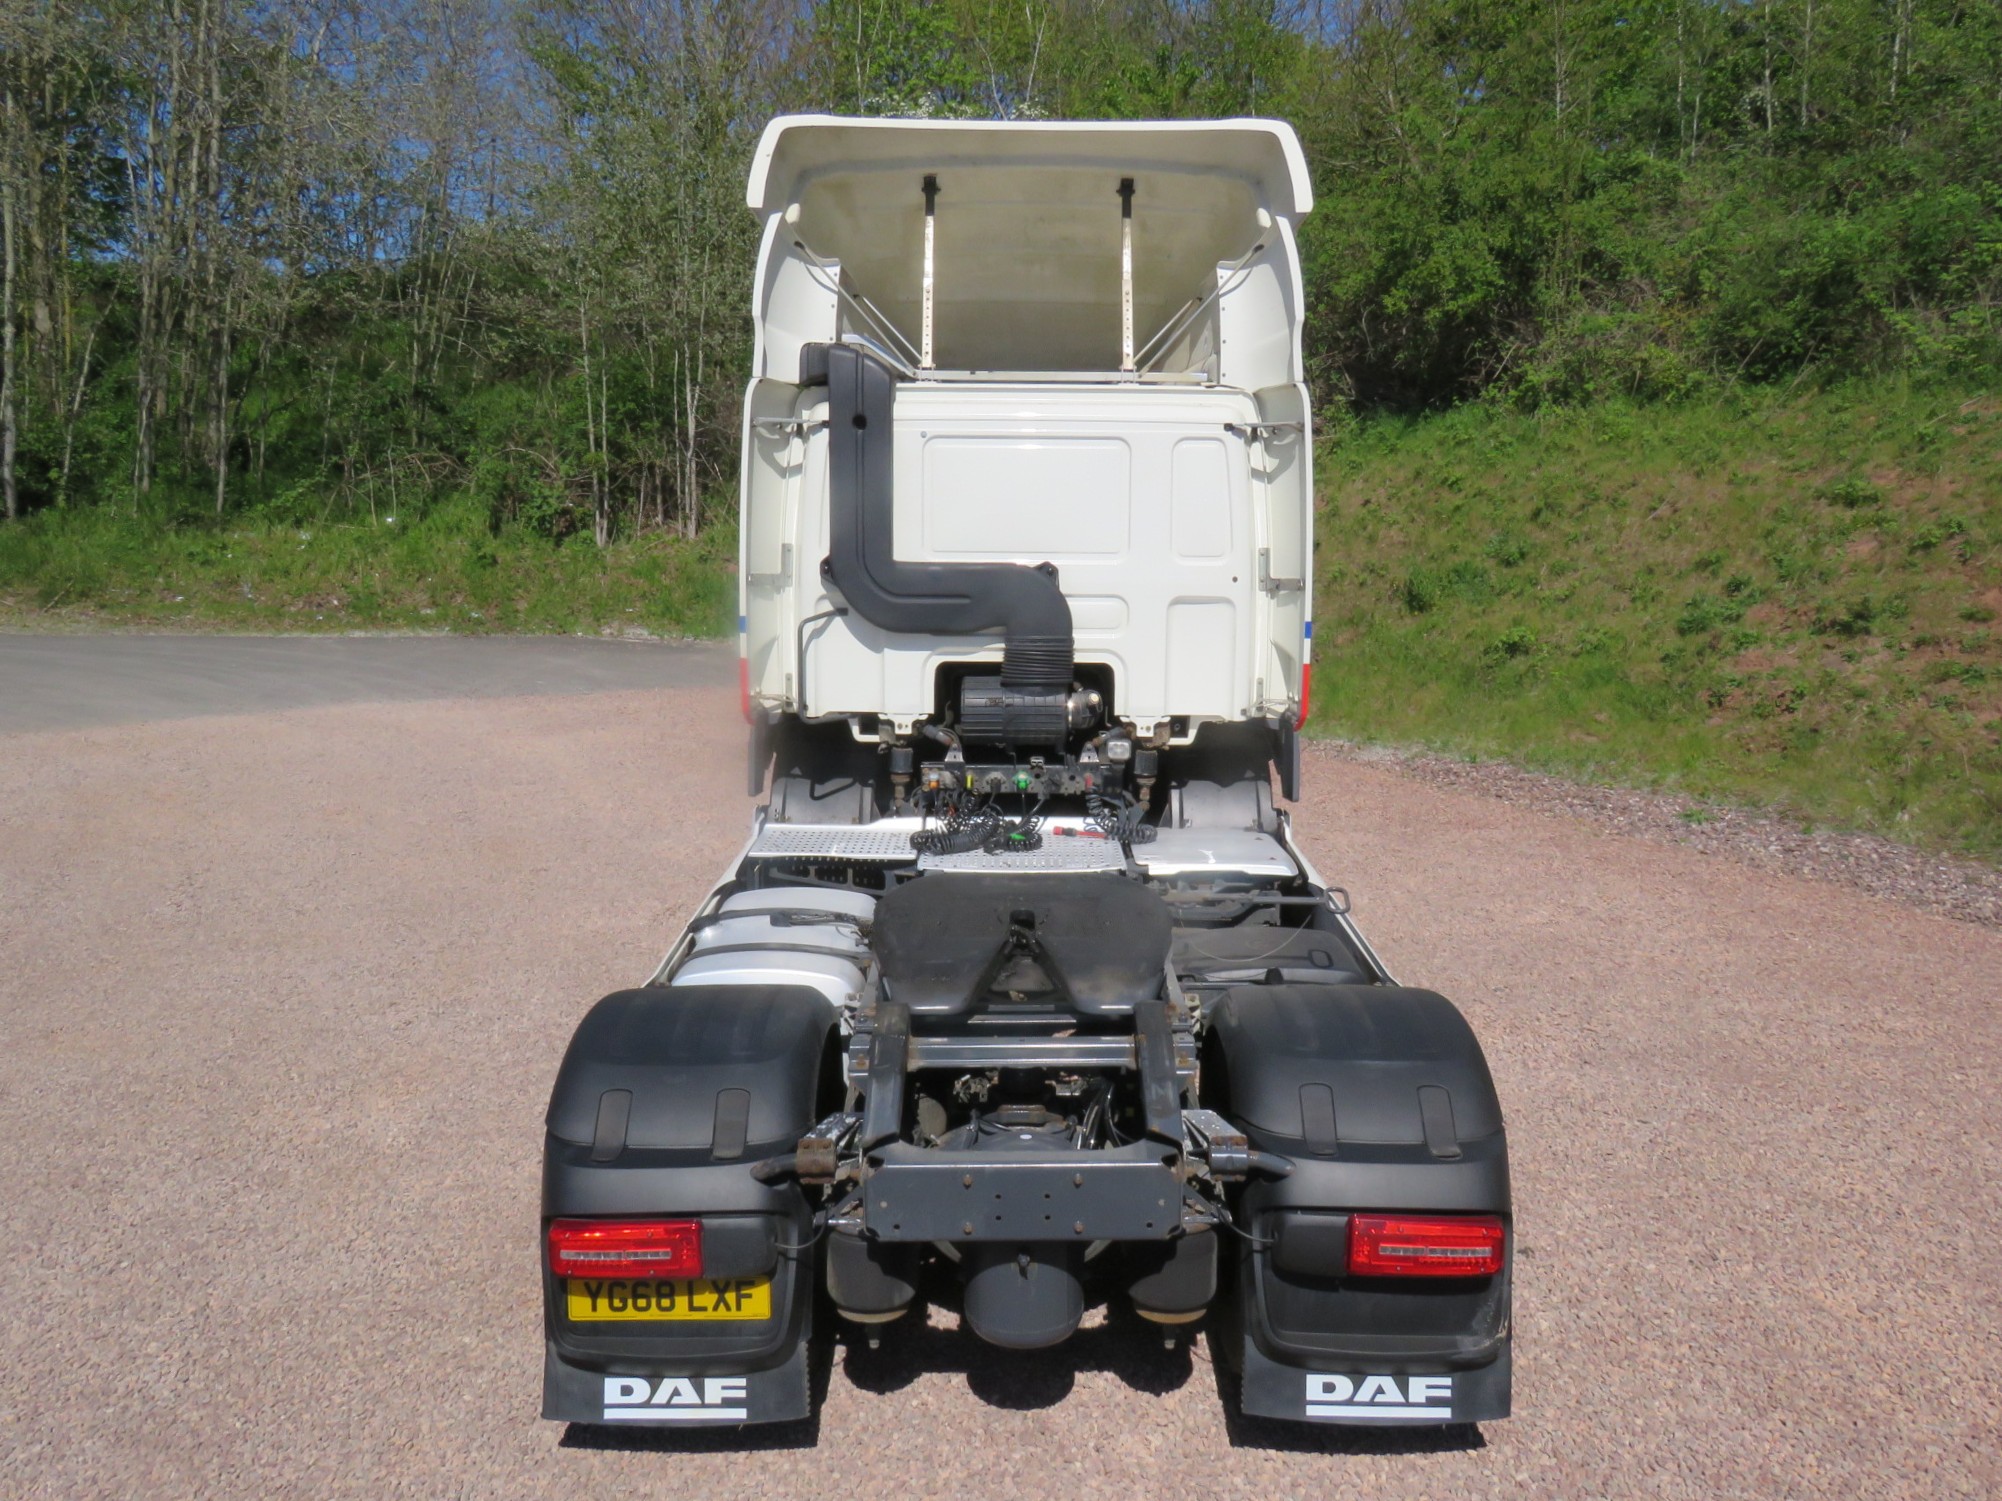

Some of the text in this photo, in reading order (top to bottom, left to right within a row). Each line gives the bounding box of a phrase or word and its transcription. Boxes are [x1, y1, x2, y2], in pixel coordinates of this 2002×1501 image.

[584, 1280, 756, 1312] YG68 LXF
[604, 1377, 747, 1404] DAF
[1306, 1374, 1452, 1403] DAF
